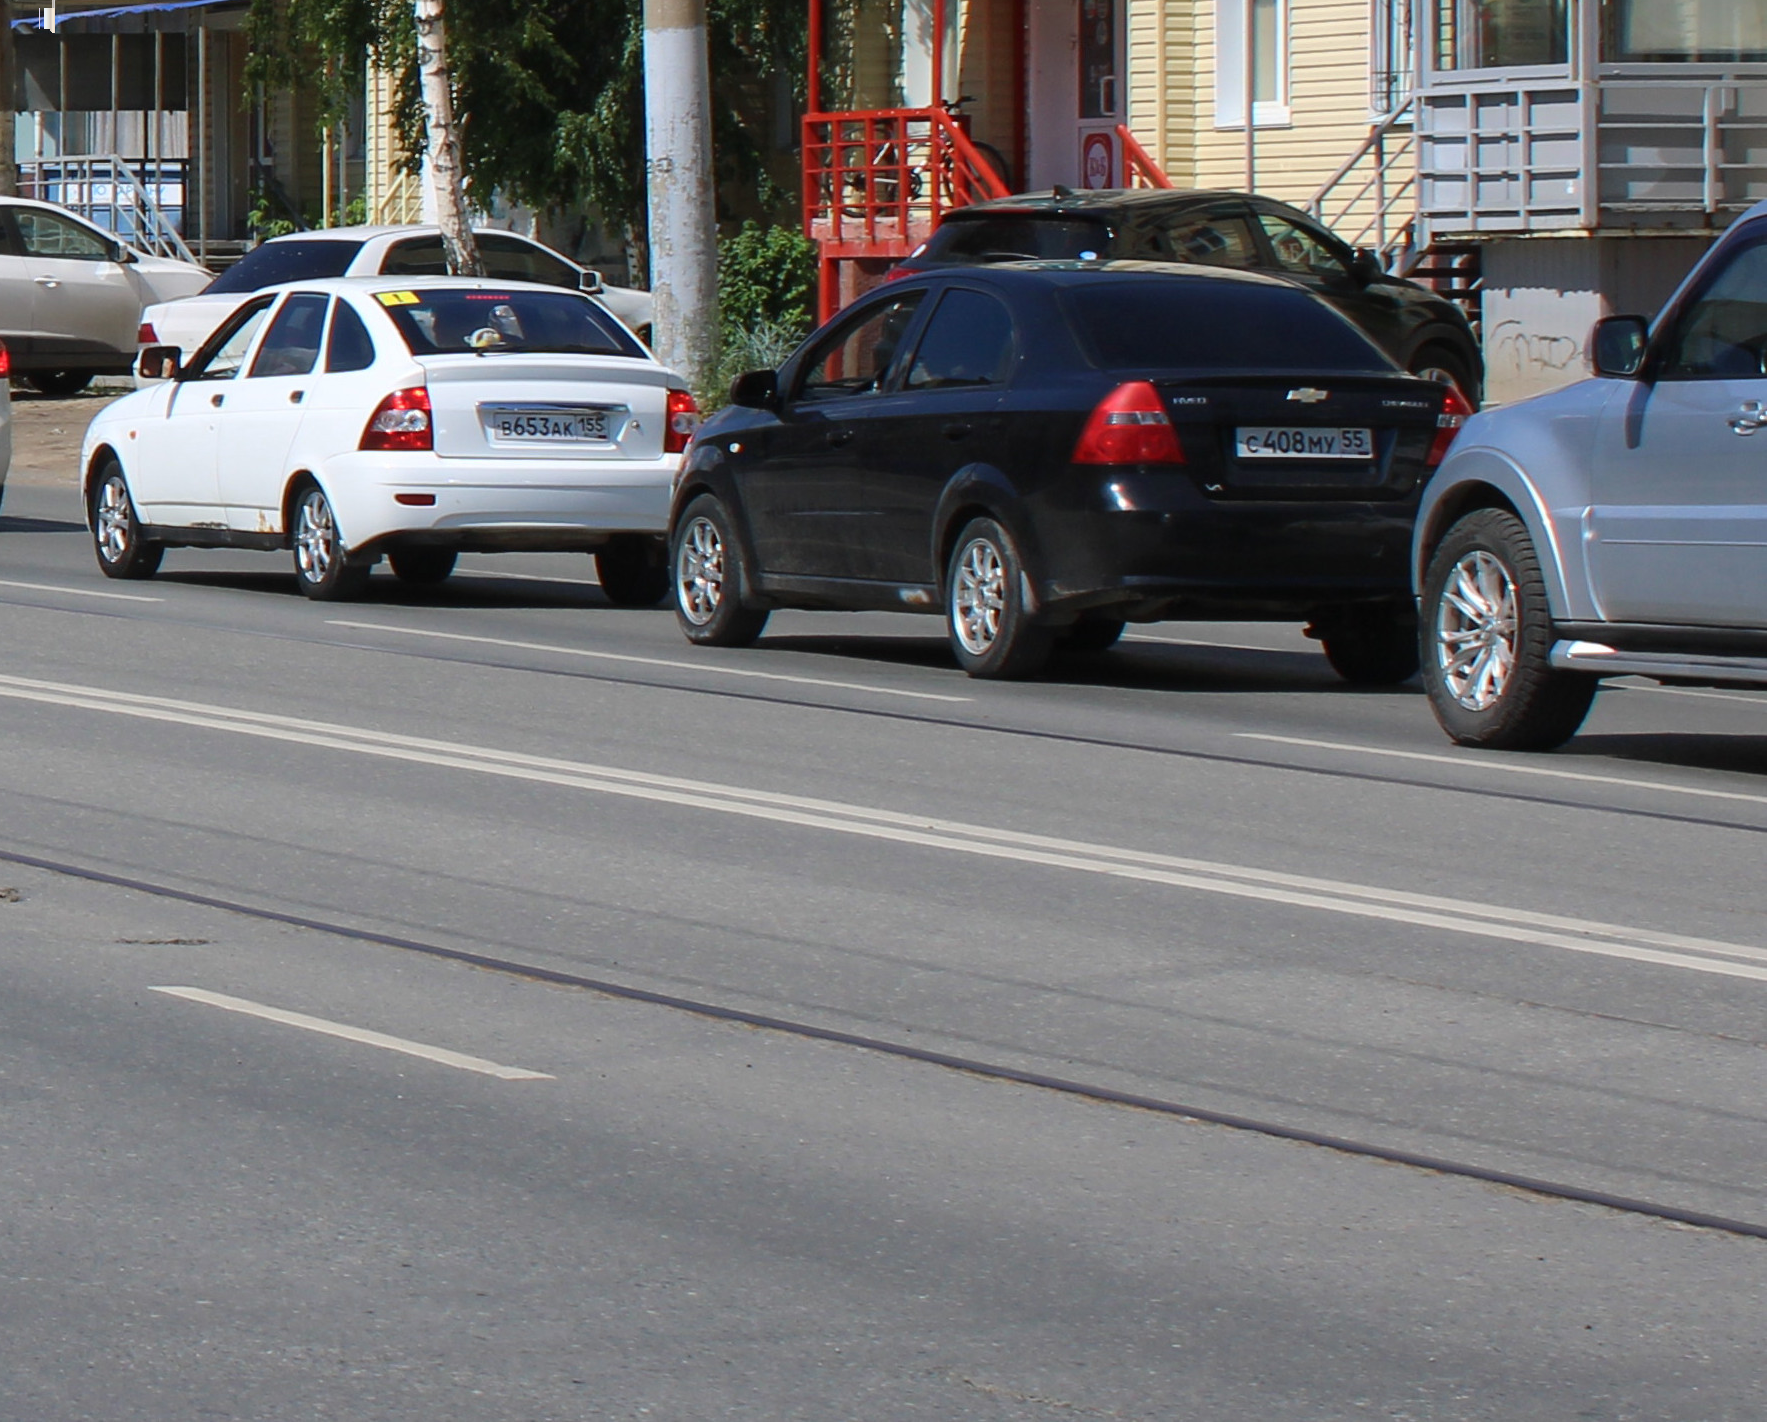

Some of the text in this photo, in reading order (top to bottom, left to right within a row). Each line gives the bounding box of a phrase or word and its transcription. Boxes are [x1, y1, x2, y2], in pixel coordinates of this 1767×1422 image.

[502, 417, 605, 437] В653АК 155
[1246, 430, 1364, 454] С408МУ 55
